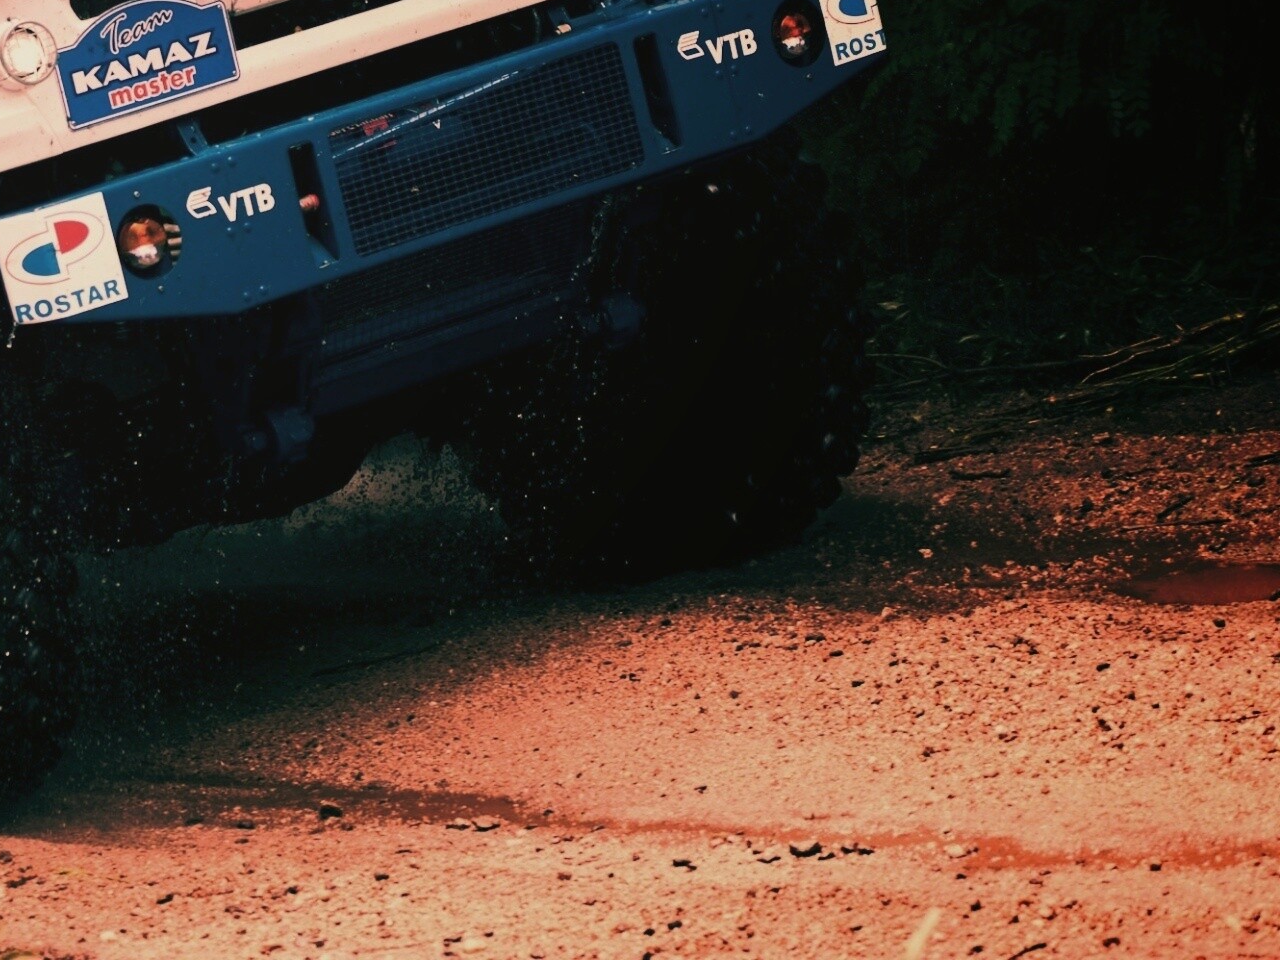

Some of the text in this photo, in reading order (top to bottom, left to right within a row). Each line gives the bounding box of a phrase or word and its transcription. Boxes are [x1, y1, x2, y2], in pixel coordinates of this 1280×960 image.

[100, 9, 172, 54] Team
[705, 28, 757, 65] VTB
[72, 31, 216, 94] KAMAZ
[109, 65, 196, 110] master
[217, 183, 275, 222] VTB
[14, 279, 121, 324] ROSTAR
